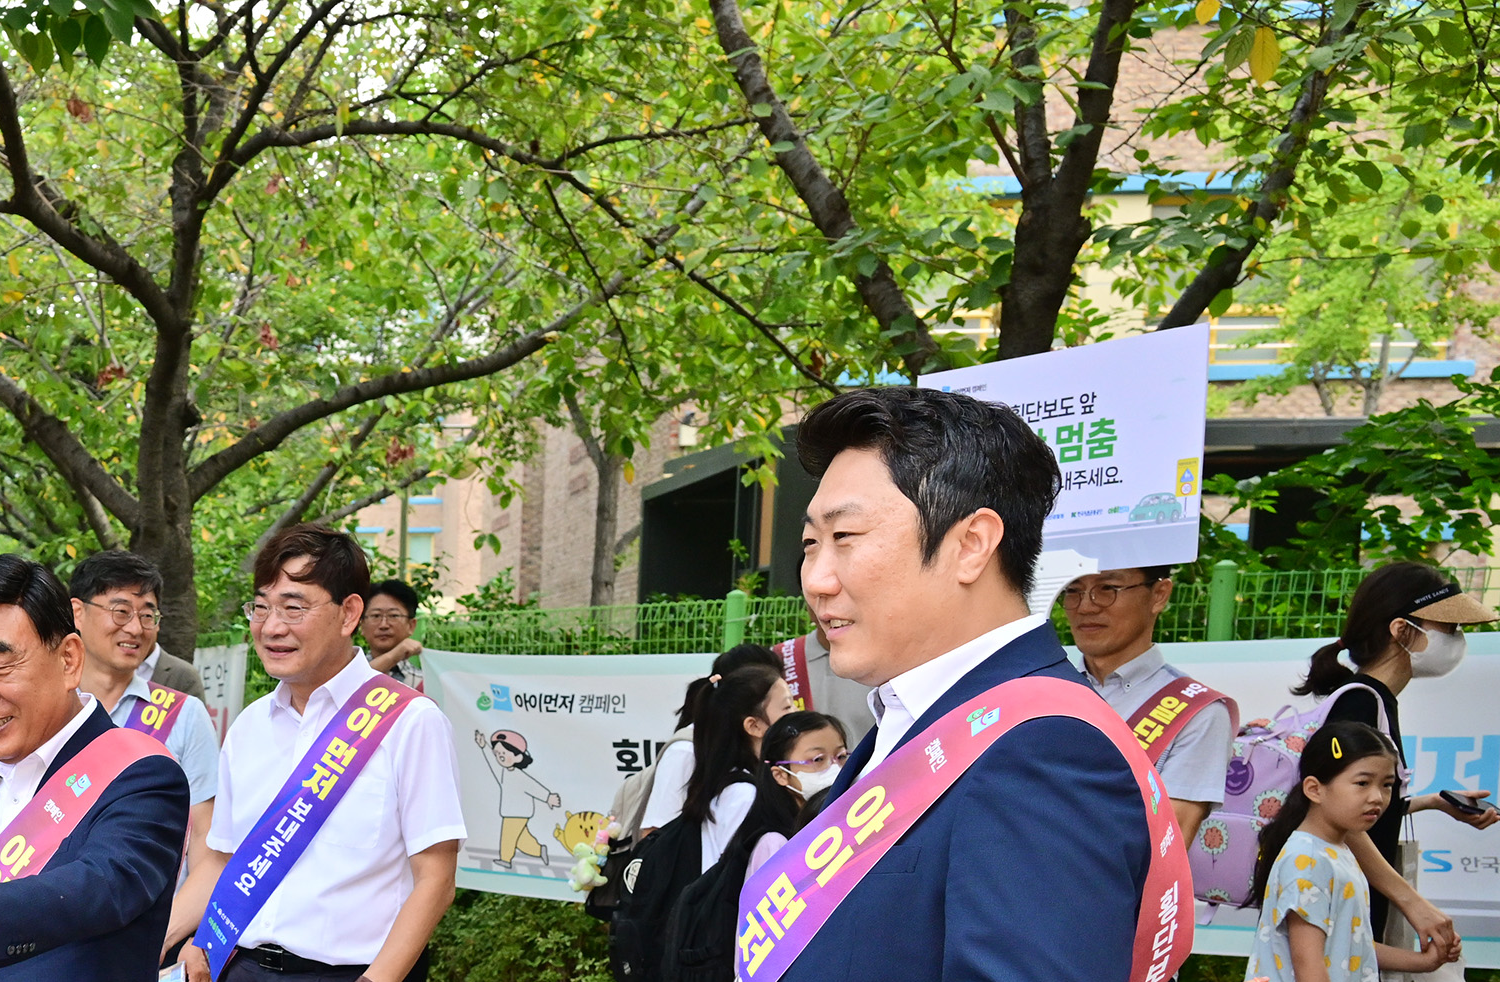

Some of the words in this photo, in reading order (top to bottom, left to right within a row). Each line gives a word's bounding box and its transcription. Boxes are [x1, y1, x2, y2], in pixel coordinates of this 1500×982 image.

[1080, 392, 1097, 415] 앞
[1056, 418, 1118, 463] 멈춤
[1060, 466, 1123, 491] 내주세요.
[1414, 593, 1432, 604] WHITE
[141, 688, 175, 730] 아이
[346, 687, 400, 739] 아이
[514, 693, 576, 714] 아이먼저
[578, 694, 627, 715] 캠페인
[302, 736, 358, 801] 먼저
[924, 737, 948, 773] 캠페인
[43, 798, 65, 824] 캠페인
[234, 796, 313, 896] 보내주세요
[805, 785, 896, 888] 아이
[738, 872, 808, 978] 먼저
